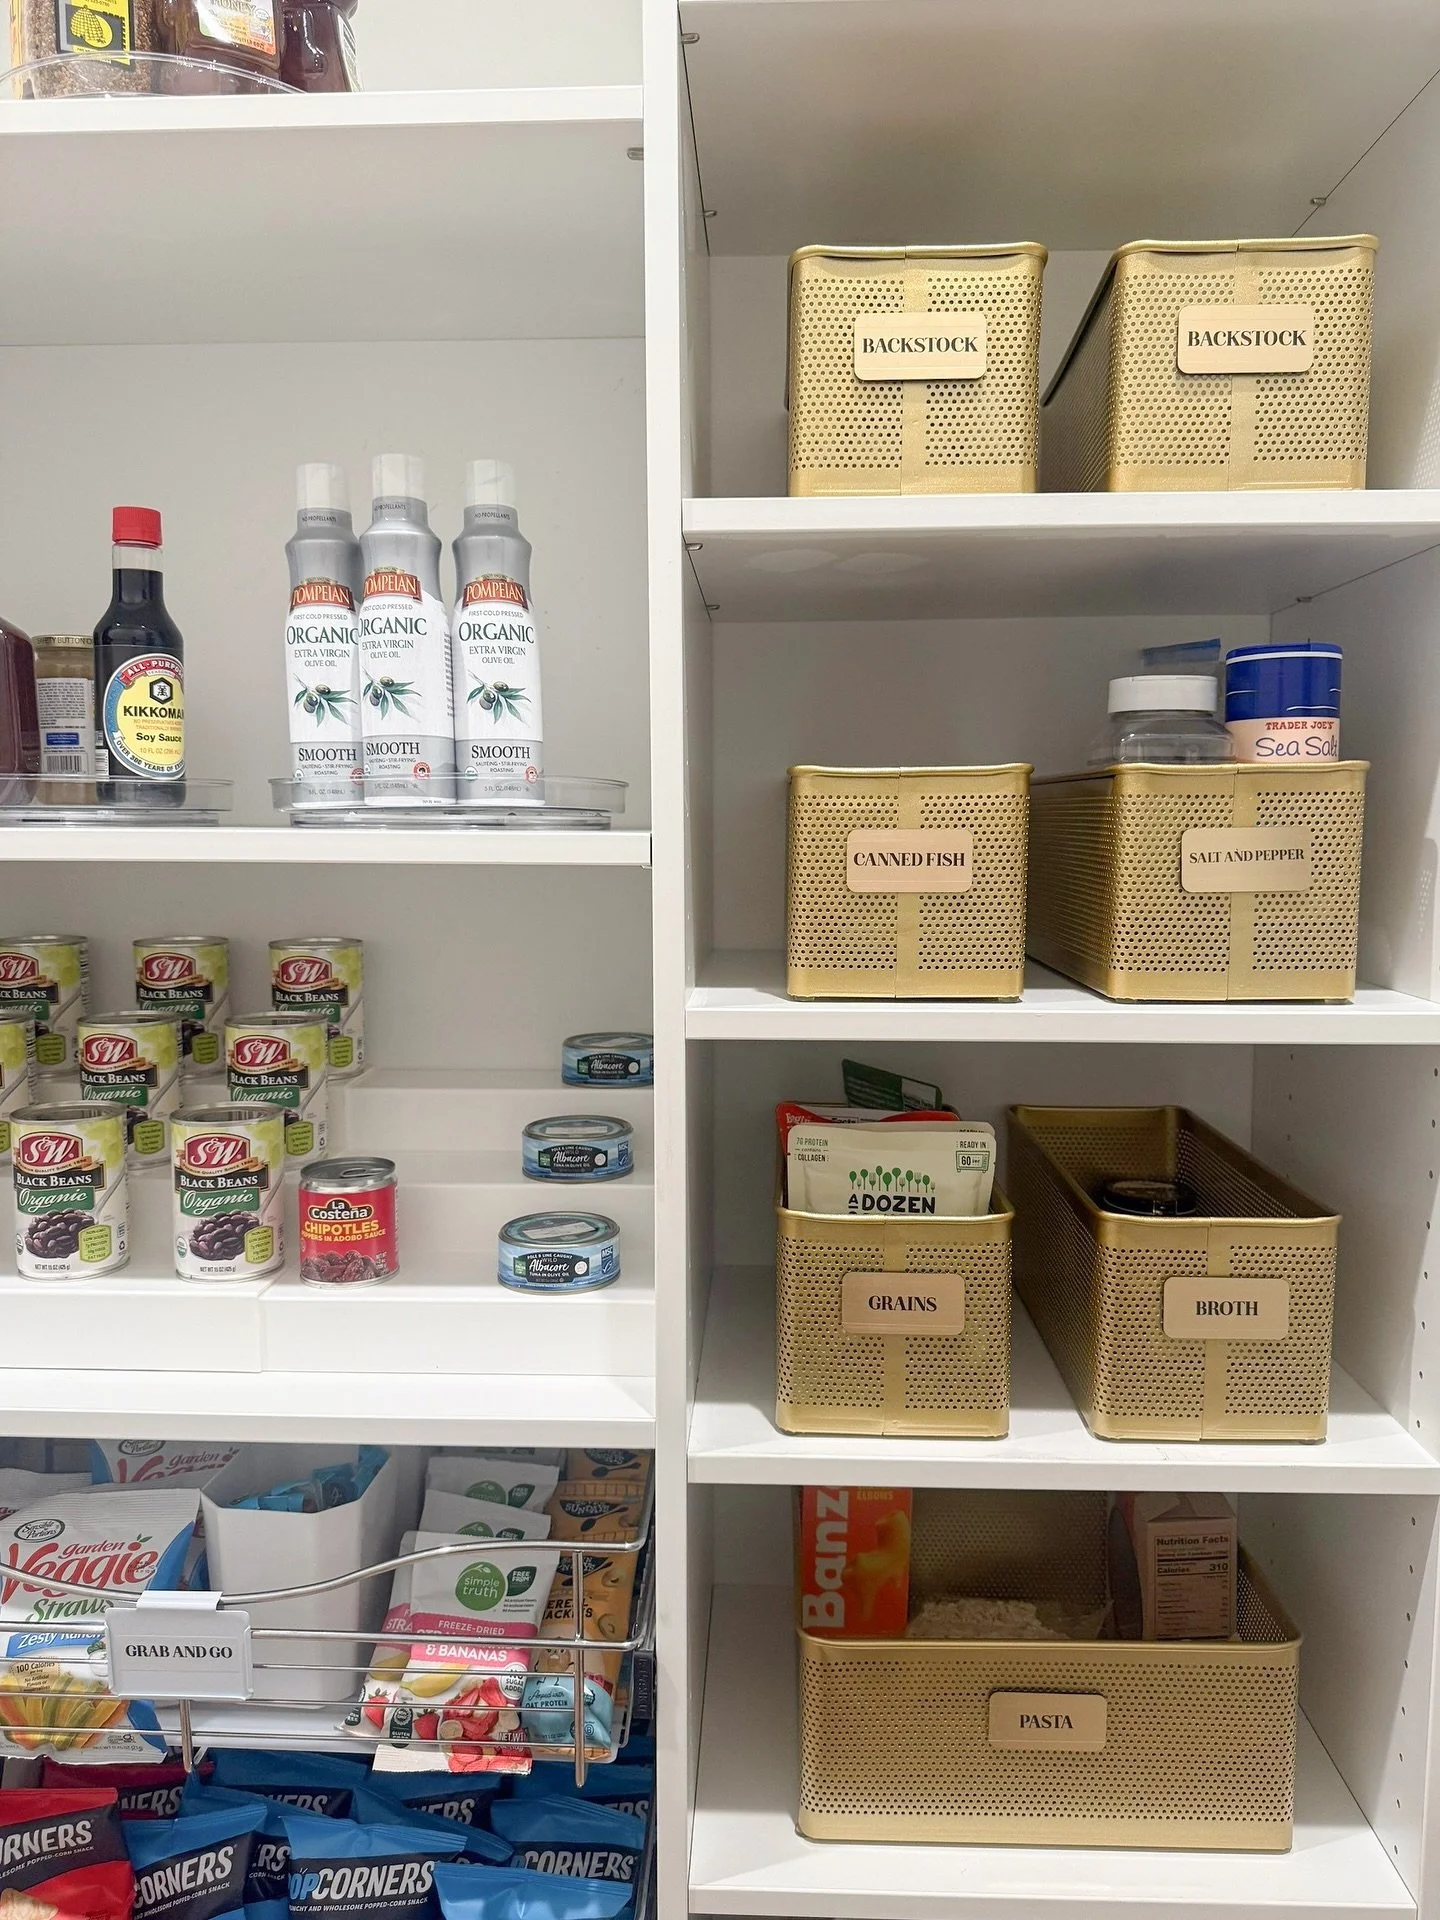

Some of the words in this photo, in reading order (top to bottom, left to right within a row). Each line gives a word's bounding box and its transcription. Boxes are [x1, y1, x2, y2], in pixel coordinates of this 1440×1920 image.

[862, 336, 979, 354] BACKSTOCK
[1187, 330, 1307, 347] BACKSTOCK
[466, 582, 524, 602] POMPEIAN
[458, 622, 535, 644] ORGANIC
[382, 640, 414, 649] VIRGIN
[469, 646, 496, 655] EXTRA
[497, 646, 526, 656] VIRGIN
[320, 649, 350, 658] VIRGIN
[1265, 721, 1308, 730] TRADER
[136, 732, 155, 743] Soy
[158, 733, 182, 743] Sauce
[366, 742, 421, 756] SMOOTH
[471, 745, 531, 759] SMOOTH
[1255, 737, 1300, 757] Sea
[299, 748, 357, 761] SMOOTH
[143, 761, 165, 772] YEARS
[853, 852, 923, 867] CANNED
[926, 852, 965, 866] FISH
[1189, 851, 1222, 864] SALT
[1224, 849, 1253, 862] AND
[1255, 848, 1305, 861] PEPPER
[12, 989, 47, 999] BEANS
[168, 988, 204, 999] BEANS
[275, 992, 303, 1003] BLACK
[304, 992, 340, 1002] BEANS
[237, 1039, 284, 1065] S&W
[107, 1072, 147, 1084] BEANS
[230, 1072, 259, 1085] BLACK
[260, 1074, 299, 1085] BEANS
[804, 1137, 829, 1147] PROTEIN
[960, 1140, 978, 1149] READY
[979, 1141, 987, 1149] IN
[24, 1136, 76, 1164] S&W
[190, 1137, 243, 1166] S&W
[553, 1151, 590, 1163] Albacore
[797, 1153, 826, 1162] COLLAGEN
[961, 1155, 971, 1166] 60
[16, 1172, 48, 1187] BLACK
[50, 1174, 92, 1187] BEANS
[180, 1174, 215, 1188] BLACK
[217, 1175, 258, 1188] BEANS
[19, 1187, 88, 1213] Organic
[182, 1189, 255, 1215] Organic
[332, 1201, 345, 1209] La
[848, 1193, 859, 1204] A
[862, 1193, 936, 1214] DOZEN
[311, 1207, 368, 1220] Costeña
[304, 1220, 379, 1236] CHIPOTLES
[335, 1234, 362, 1242] ADOBO
[364, 1228, 387, 1239] SAUCE
[529, 1259, 570, 1273] Albacore
[868, 1295, 938, 1312] GRAINS
[1195, 1300, 1258, 1316] BROTH
[165, 1451, 220, 1470] garden
[1156, 1537, 1200, 1546] Nutrition
[1202, 1535, 1229, 1544] Facts
[58, 1540, 125, 1559] garden
[802, 1485, 849, 1629] Banz
[1, 1542, 159, 1605] Veggie
[512, 1570, 531, 1578] FREE
[1157, 1566, 1190, 1574] Calories
[1209, 1563, 1229, 1571] 310
[464, 1576, 500, 1588] simple
[463, 1586, 498, 1599] truth
[438, 1620, 505, 1636] FREEZE-DRIED
[17, 1632, 58, 1649] Zesty
[126, 1644, 169, 1657] GRAB
[172, 1645, 207, 1658] AND
[209, 1646, 233, 1659] GO
[425, 1644, 436, 1656] &
[438, 1644, 508, 1661] BANANAS
[16, 1663, 30, 1674] 100
[540, 1700, 568, 1708] PROTEIN
[1019, 1714, 1073, 1729] PASTA
[26, 1850, 73, 1867] POPPED-CORN
[73, 1846, 95, 1854] SNACK
[144, 1900, 173, 1918] WHOLESOME
[172, 1888, 207, 1906] POPPED-CORN
[208, 1881, 231, 1894] SNACK
[323, 1903, 364, 1912] WHOLESOME
[364, 1900, 406, 1910] POPPED-CORN
[407, 1897, 428, 1906] SNACK
